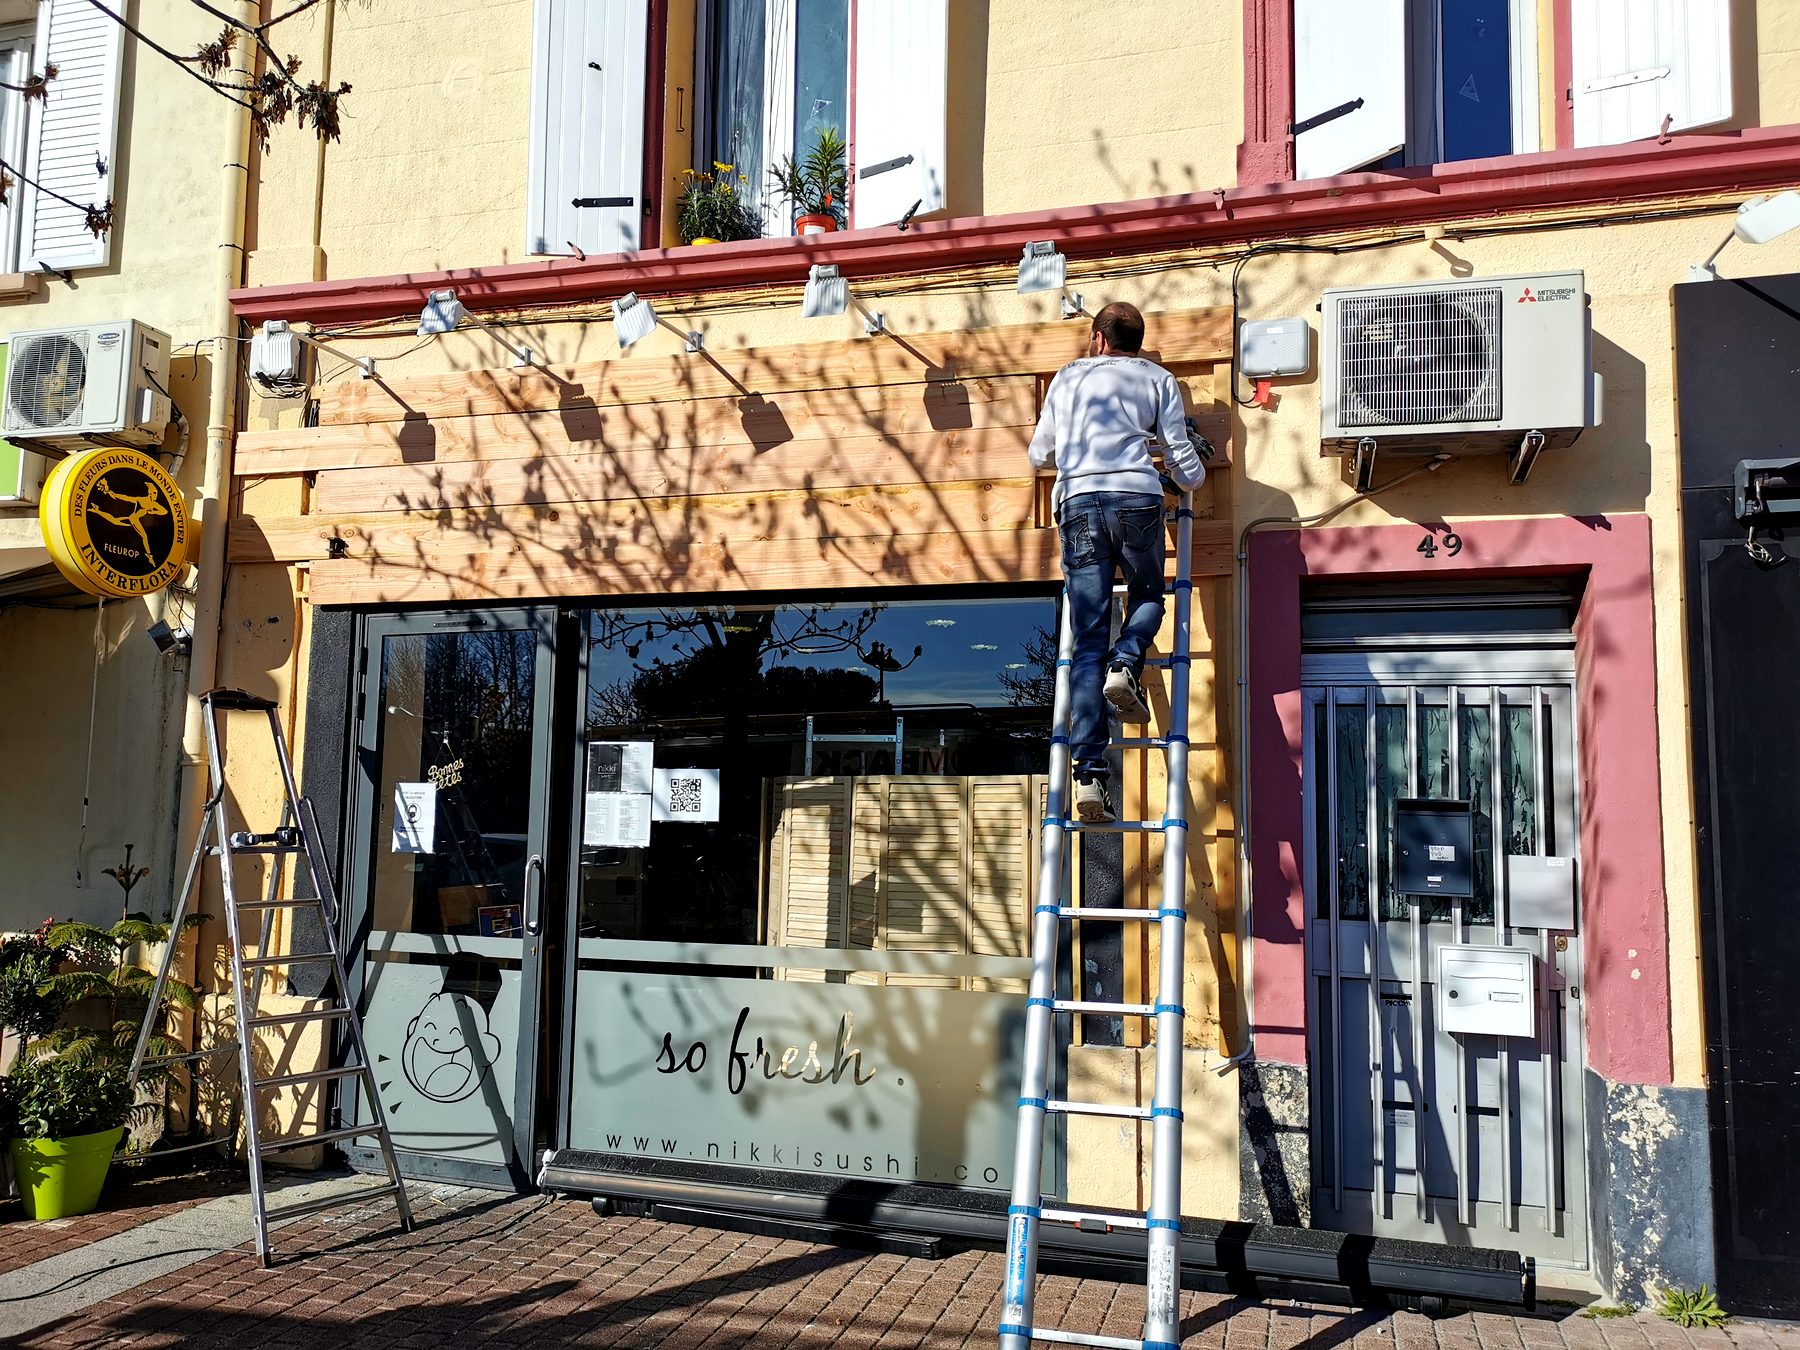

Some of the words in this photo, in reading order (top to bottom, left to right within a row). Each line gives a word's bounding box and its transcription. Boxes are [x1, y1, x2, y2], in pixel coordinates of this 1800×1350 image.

[1537, 288, 1576, 296] MITSUBISHI
[1537, 294, 1571, 302] ELECTRIC
[108, 454, 134, 465] DANS
[136, 458, 149, 470] LE
[79, 459, 108, 493] FLEURS
[149, 466, 177, 501] MONDE
[74, 493, 85, 517] DES
[173, 502, 185, 545] ENTIER
[104, 543, 140, 559] FLEUROP
[1416, 533, 1463, 558] 49
[81, 543, 178, 592] INTERFLORA
[427, 758, 464, 783] Bonnes
[655, 1032, 708, 1074] so
[727, 1006, 877, 1095] fresh
[605, 1132, 1000, 1183] www.nikkisushi.co
